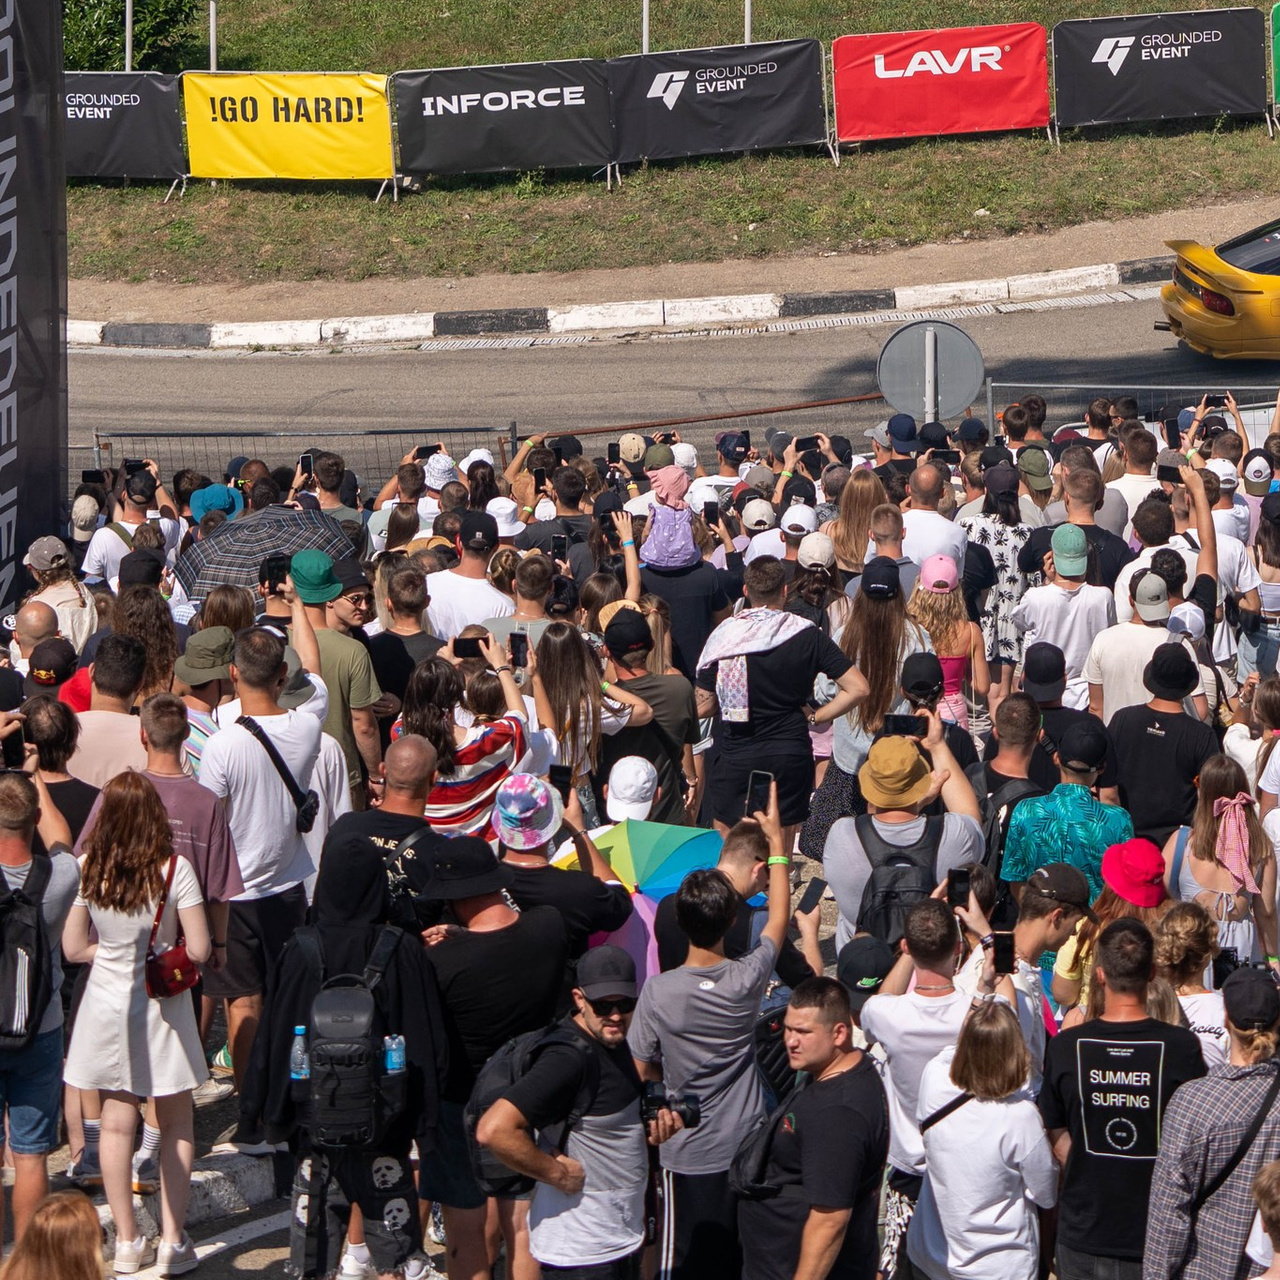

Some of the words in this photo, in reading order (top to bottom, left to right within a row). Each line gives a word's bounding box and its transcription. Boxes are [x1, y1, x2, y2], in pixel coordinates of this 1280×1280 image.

[1141, 30, 1222, 46] GROUNDED
[1141, 45, 1192, 61] EVENT
[694, 61, 778, 81] GROUNDED
[695, 77, 747, 95] EVENT
[65, 93, 141, 106] GROUNDED
[422, 85, 586, 117] INFORCE
[66, 107, 113, 119] EVENT
[209, 96, 259, 123] !GO
[273, 96, 364, 123] HARD!
[1089, 1069, 1152, 1087] SUMMER
[1091, 1092, 1151, 1109] SURFING
